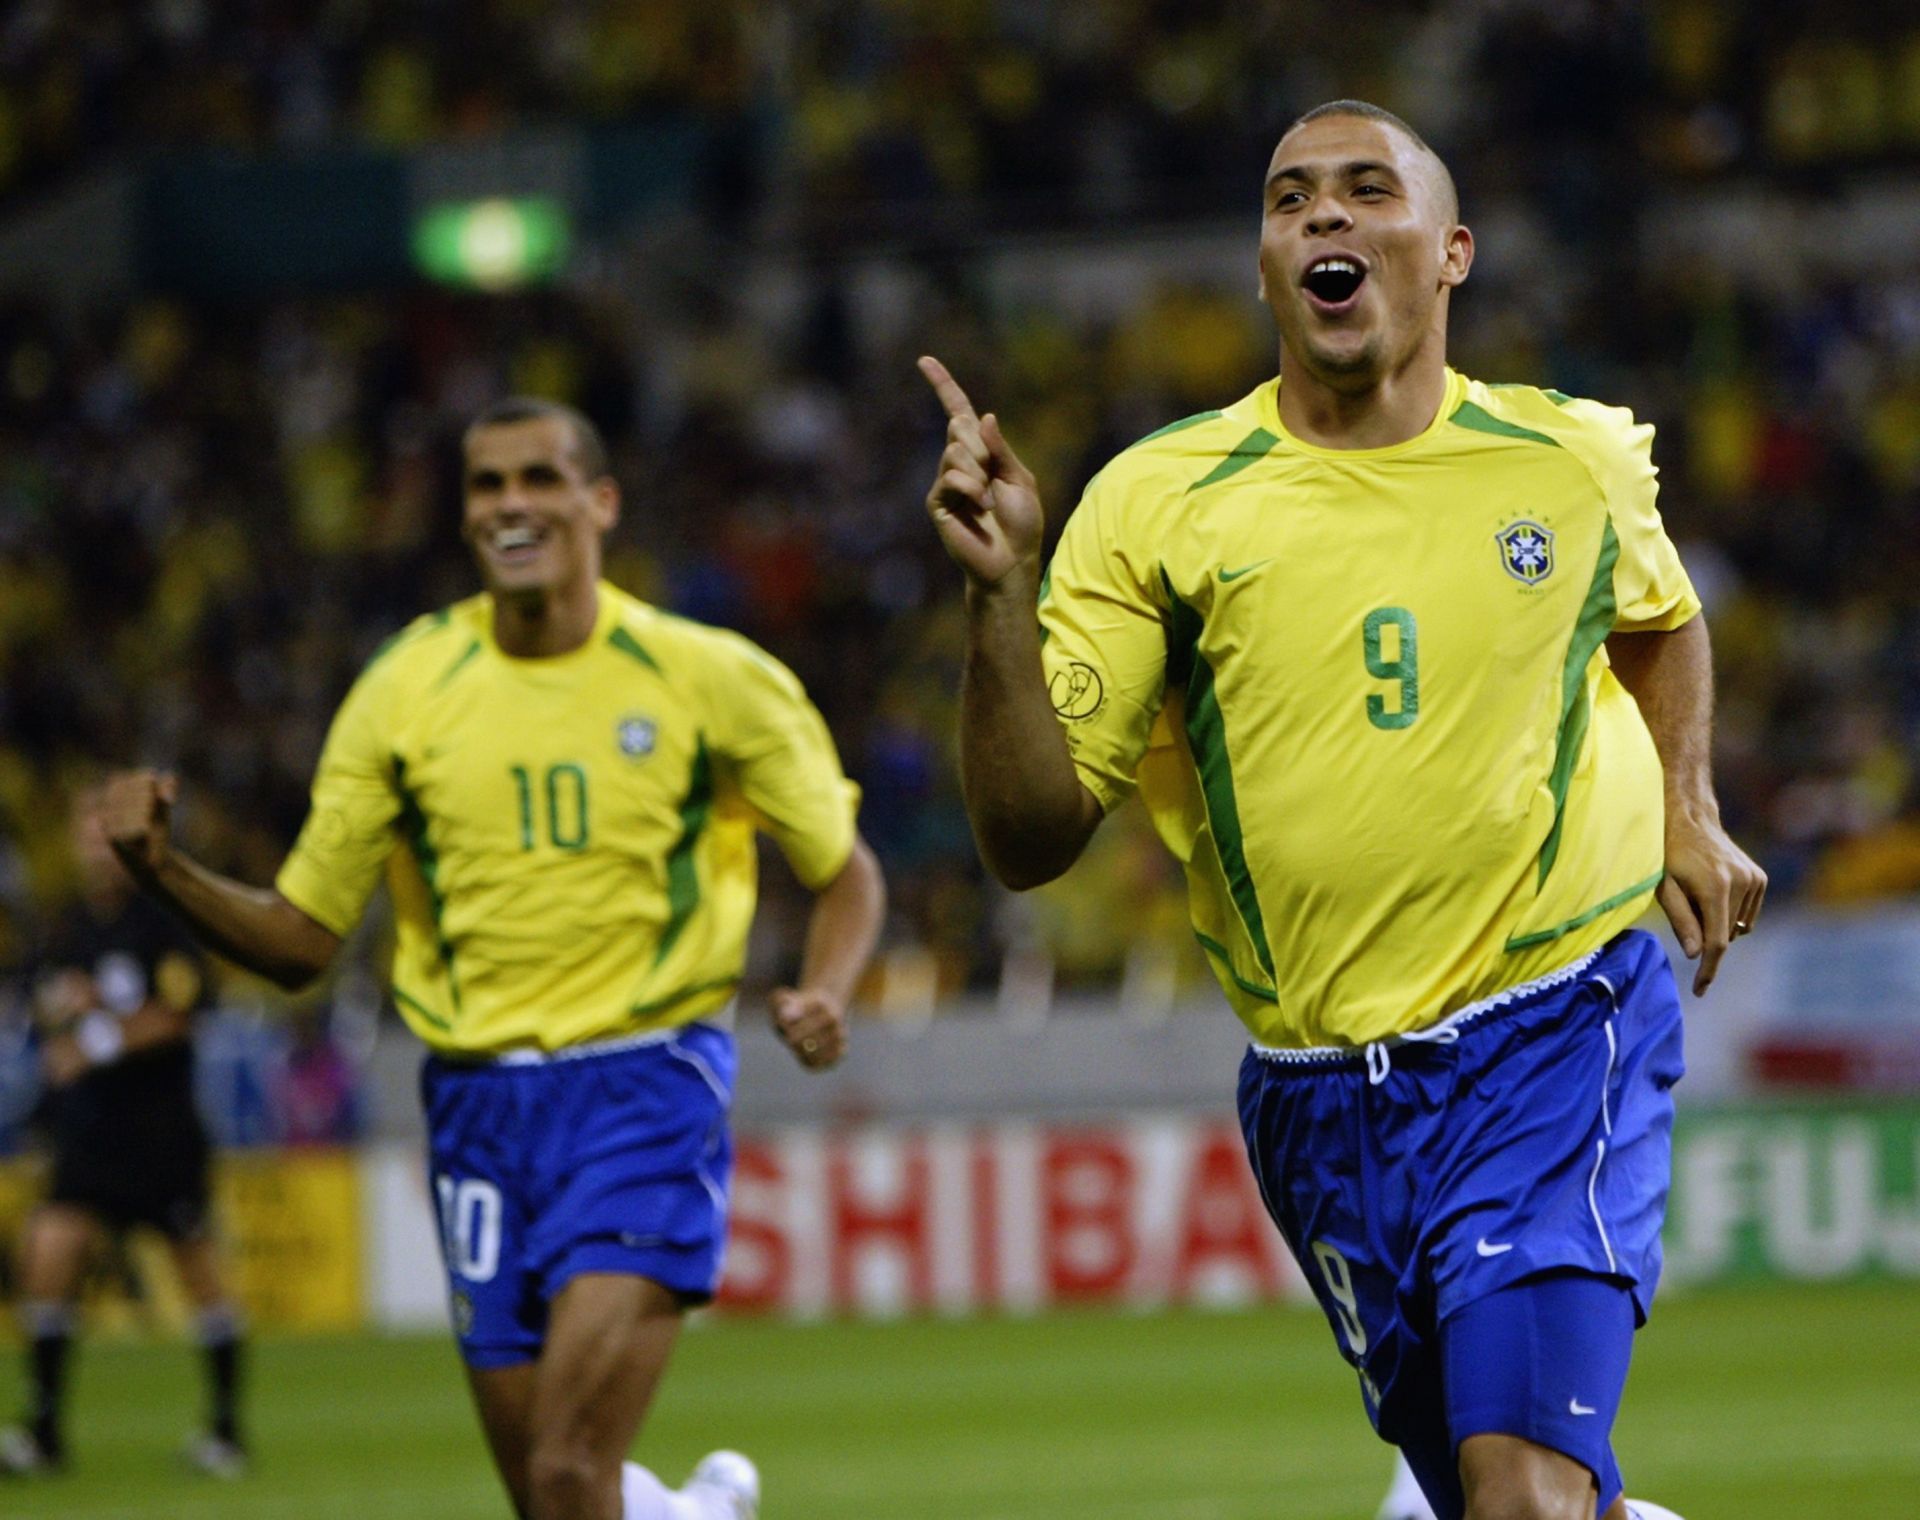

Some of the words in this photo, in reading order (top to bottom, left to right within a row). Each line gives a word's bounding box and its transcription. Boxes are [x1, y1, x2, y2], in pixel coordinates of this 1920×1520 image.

[1362, 606, 1418, 730] 9
[510, 764, 588, 851] 10
[1311, 1241, 1367, 1355] 9
